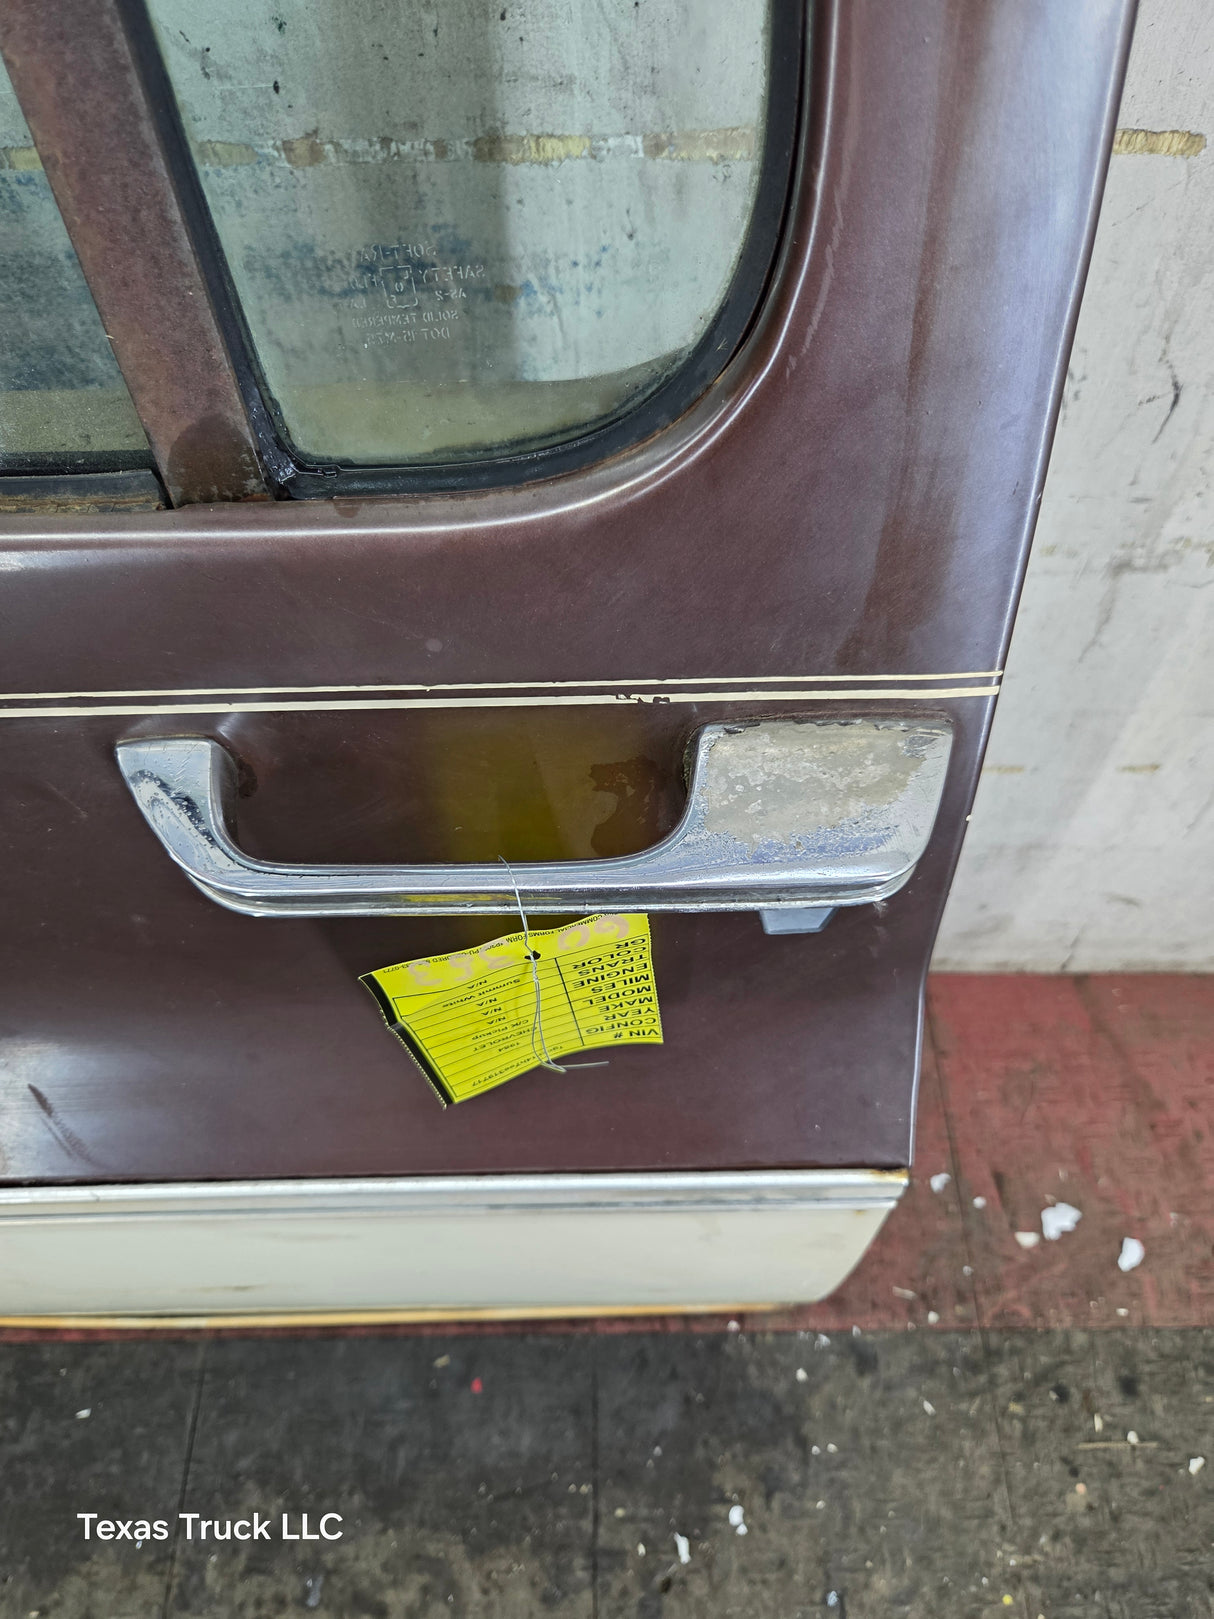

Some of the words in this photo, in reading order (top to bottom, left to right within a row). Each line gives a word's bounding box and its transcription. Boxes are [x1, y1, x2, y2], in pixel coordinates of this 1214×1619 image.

[615, 938, 646, 950] GR
[572, 946, 647, 970] COLOR
[578, 954, 645, 977] TRANS
[572, 962, 648, 989] ENGINE
[467, 979, 489, 990] N/A
[478, 978, 521, 997] Summit
[591, 973, 650, 994] MILES
[442, 995, 476, 1008] White
[476, 997, 498, 1007] N/A
[582, 985, 652, 1006] MODEL
[481, 1006, 502, 1016] N/A
[596, 995, 653, 1012] MAKE
[486, 1016, 507, 1025] N/A
[604, 1006, 655, 1021] YEAR
[511, 1019, 529, 1028] C/K
[585, 1017, 657, 1034] CONFIG
[472, 1026, 508, 1041] Pickup
[613, 1031, 623, 1039] #
[629, 1028, 659, 1038] VIN
